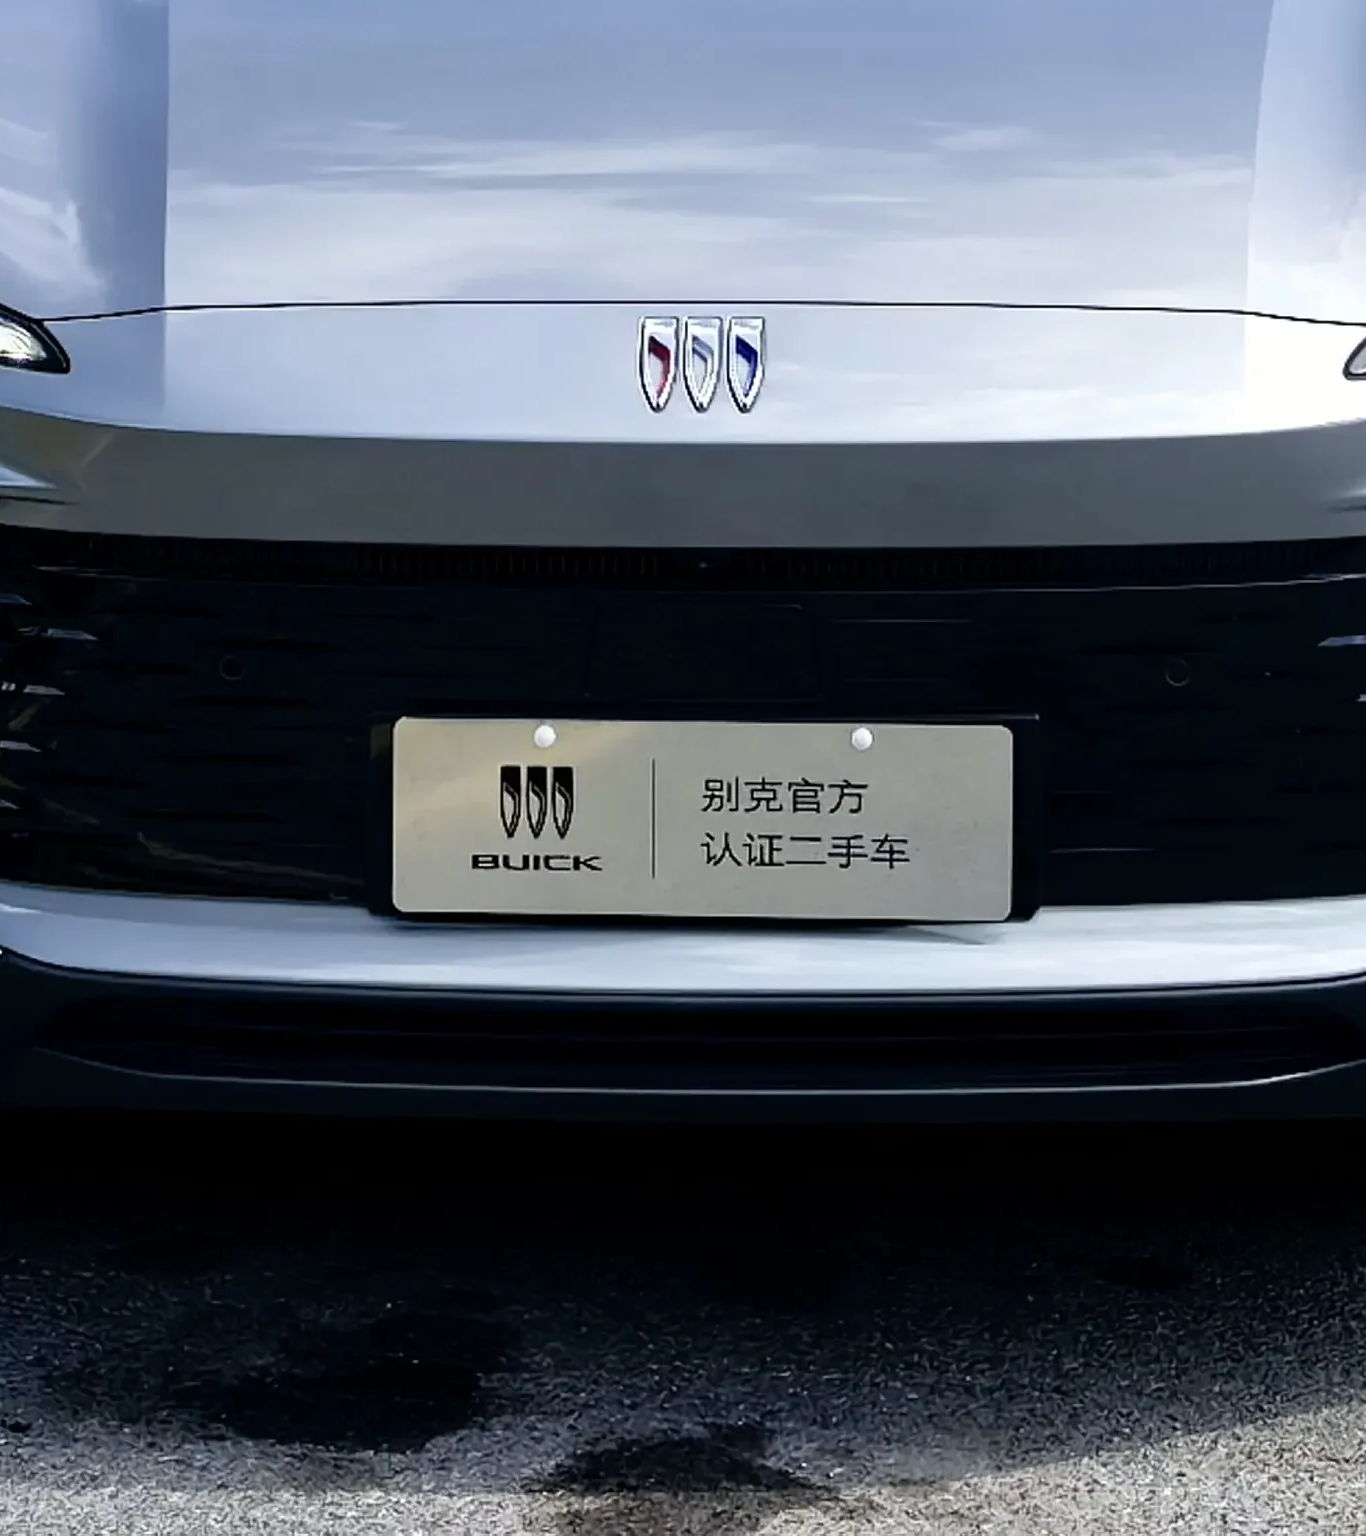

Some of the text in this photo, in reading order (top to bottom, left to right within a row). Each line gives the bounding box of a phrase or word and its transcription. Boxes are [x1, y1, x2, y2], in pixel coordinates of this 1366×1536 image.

[701, 776, 869, 814] 别克官方
[471, 854, 603, 872] BUICK
[700, 831, 911, 870] 认证二手车
